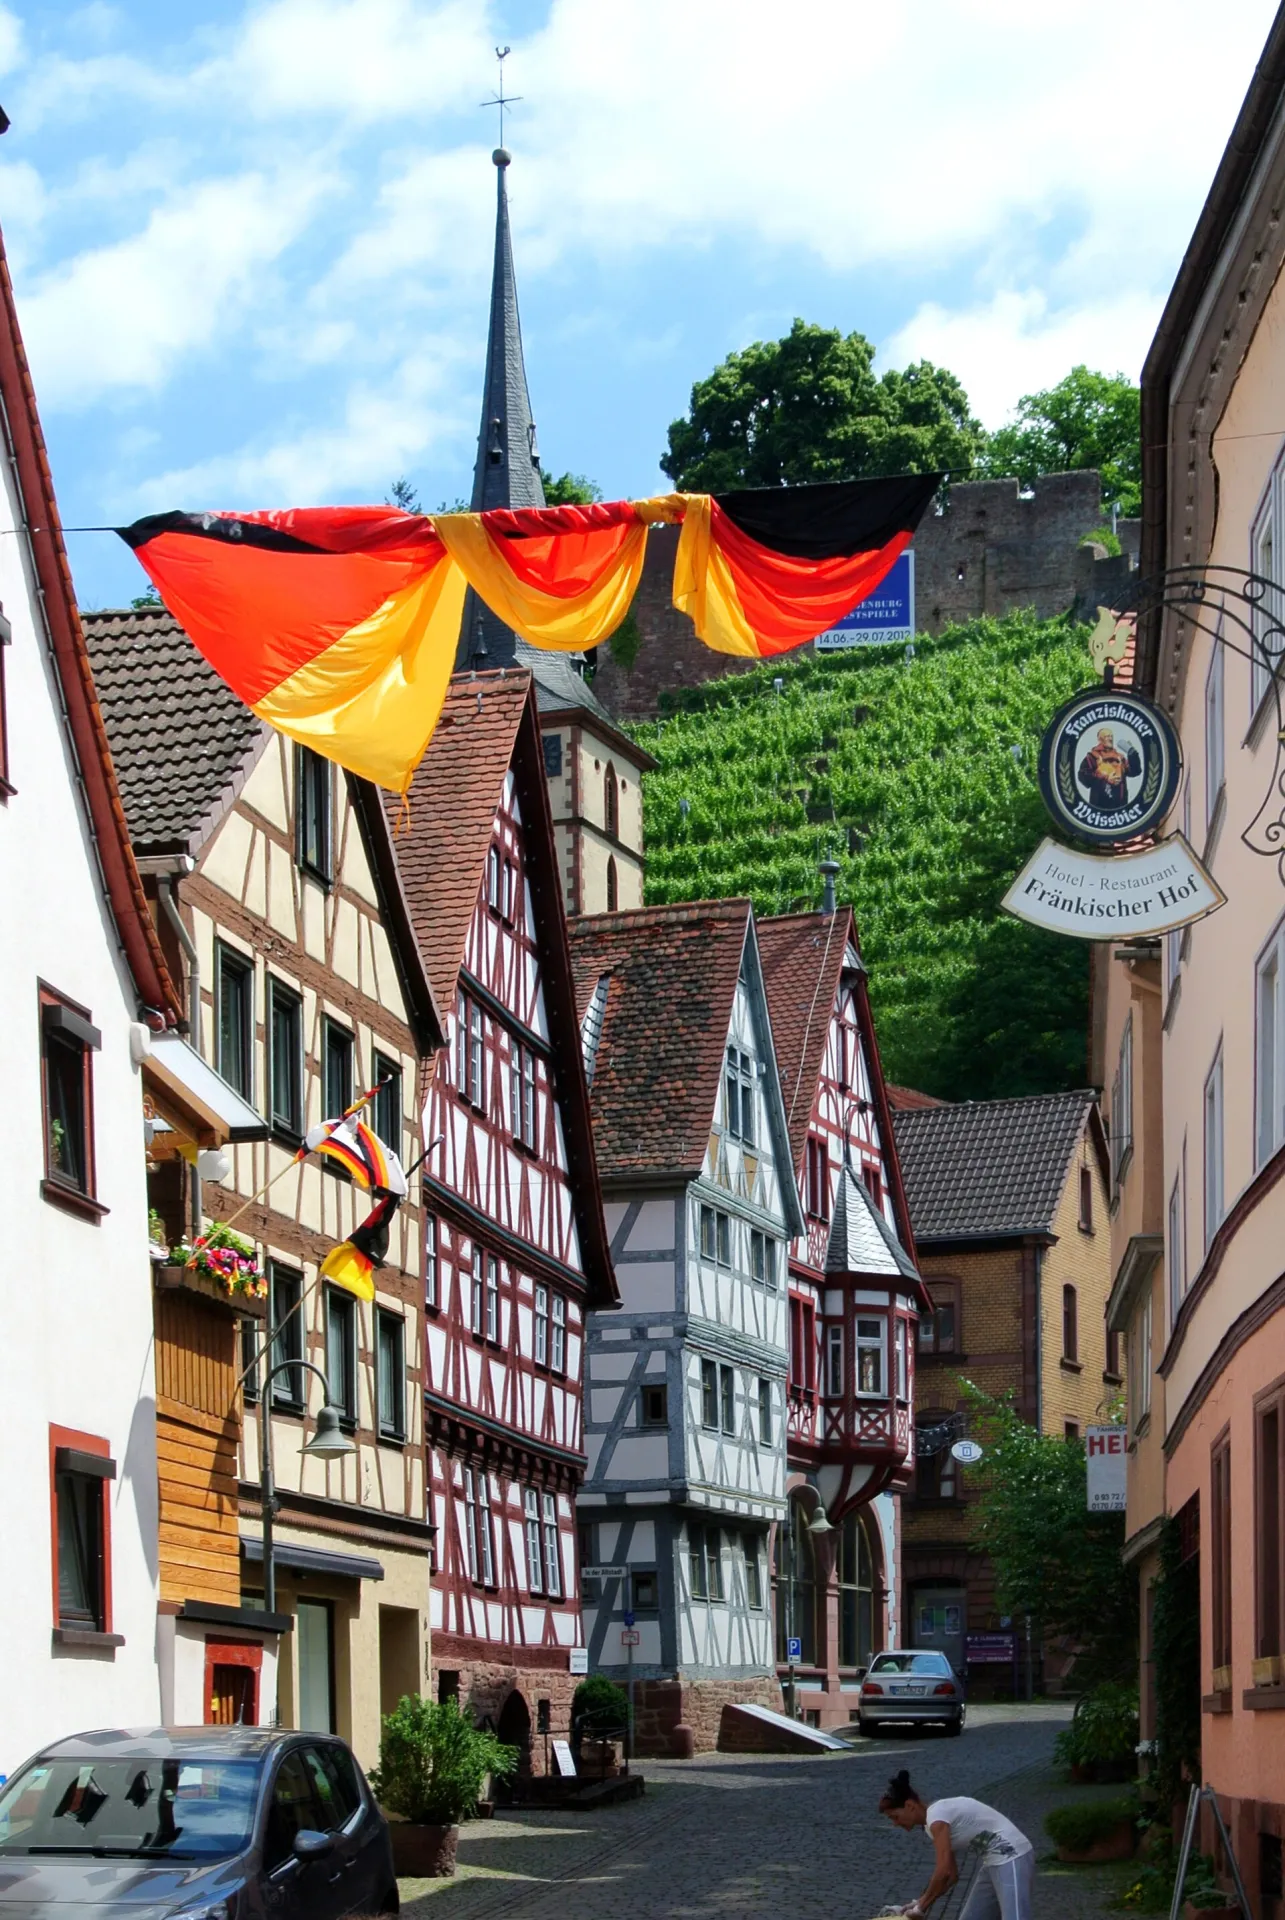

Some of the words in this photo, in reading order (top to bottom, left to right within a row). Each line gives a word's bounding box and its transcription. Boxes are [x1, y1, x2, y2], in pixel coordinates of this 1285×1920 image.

[1065, 704, 1153, 739] Franziskaner
[1073, 801, 1143, 827] Weissbier
[1045, 863, 1085, 888] Hotel
[1100, 863, 1179, 891] Restaurant
[1022, 877, 1153, 918] Fränkischer
[1156, 873, 1200, 909] Hof
[789, 1640, 798, 1654] P
